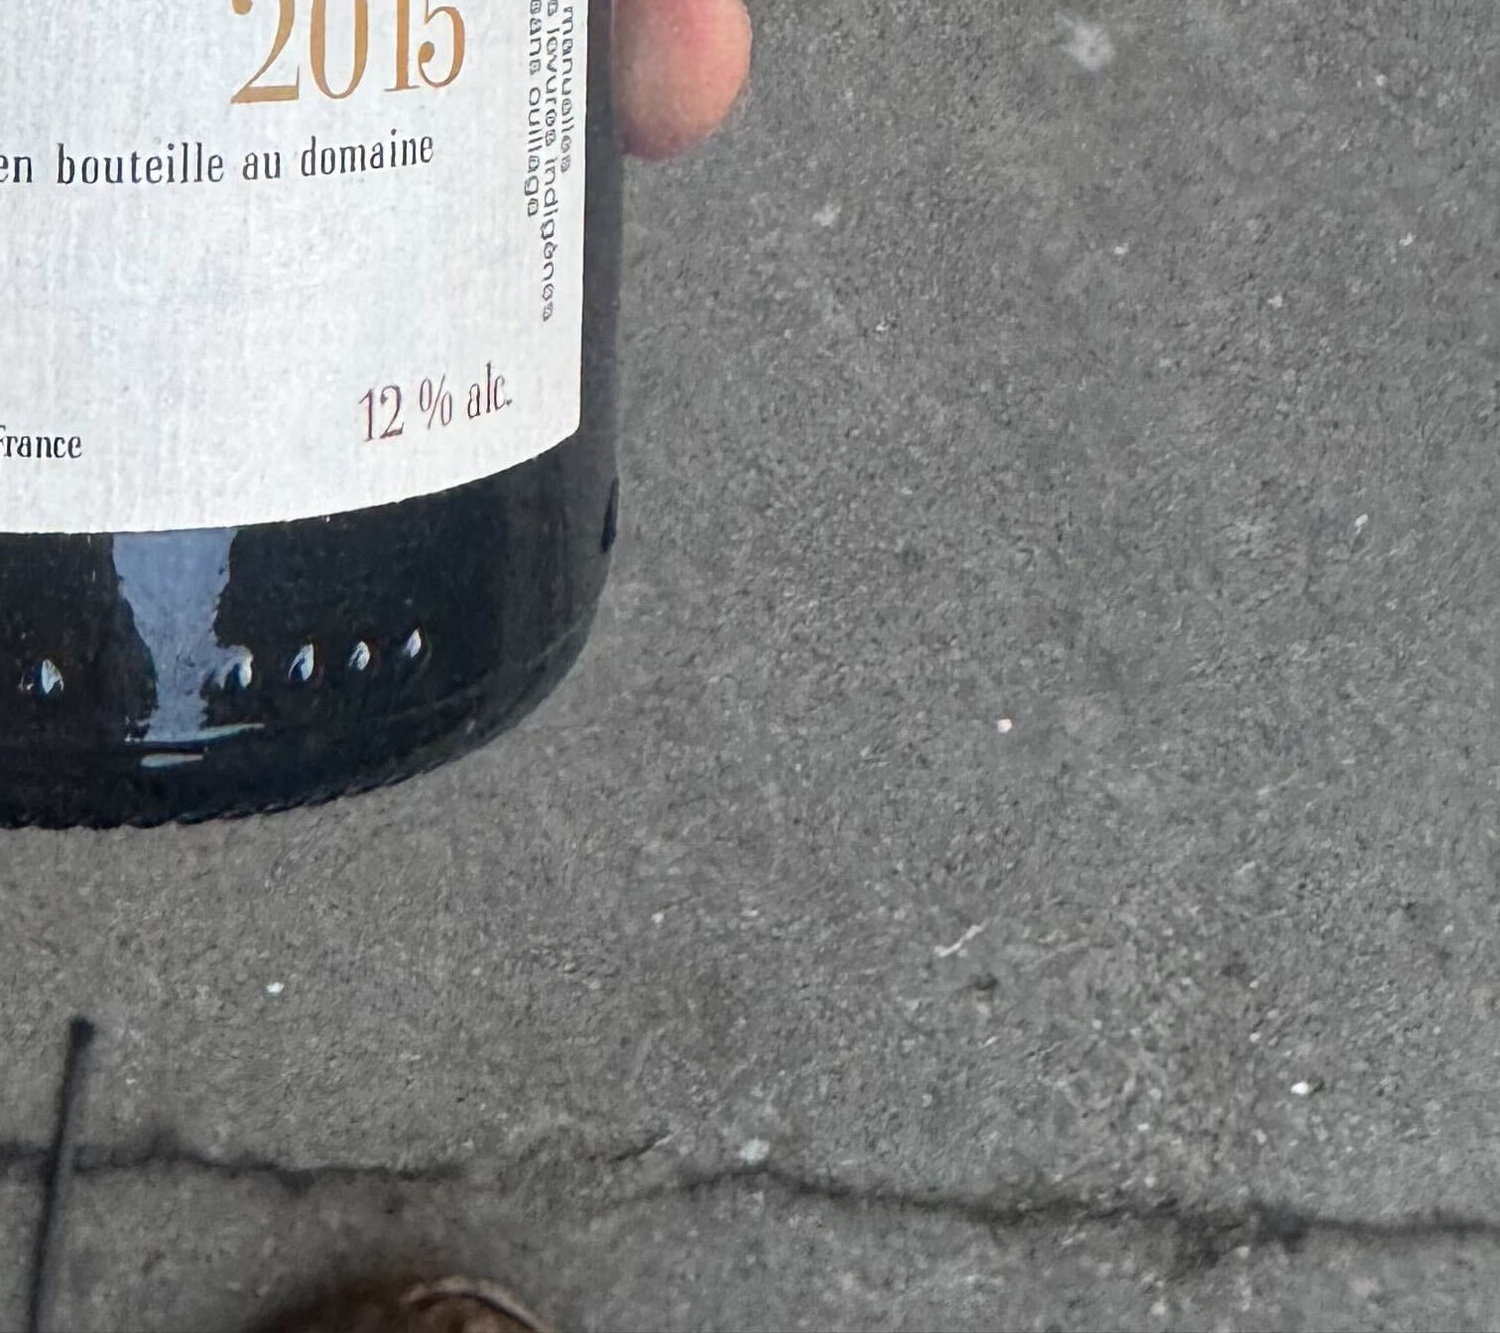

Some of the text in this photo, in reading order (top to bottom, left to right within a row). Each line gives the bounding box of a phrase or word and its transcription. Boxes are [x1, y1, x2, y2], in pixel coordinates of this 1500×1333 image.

[529, 0, 542, 76] sans
[545, 30, 560, 146] levures
[561, 7, 574, 173] manuelles
[57, 142, 224, 184] bouteille
[243, 152, 280, 180] au
[301, 129, 433, 176] domaine
[524, 87, 541, 217] ouillage
[358, 362, 513, 441] 12 % alc.
